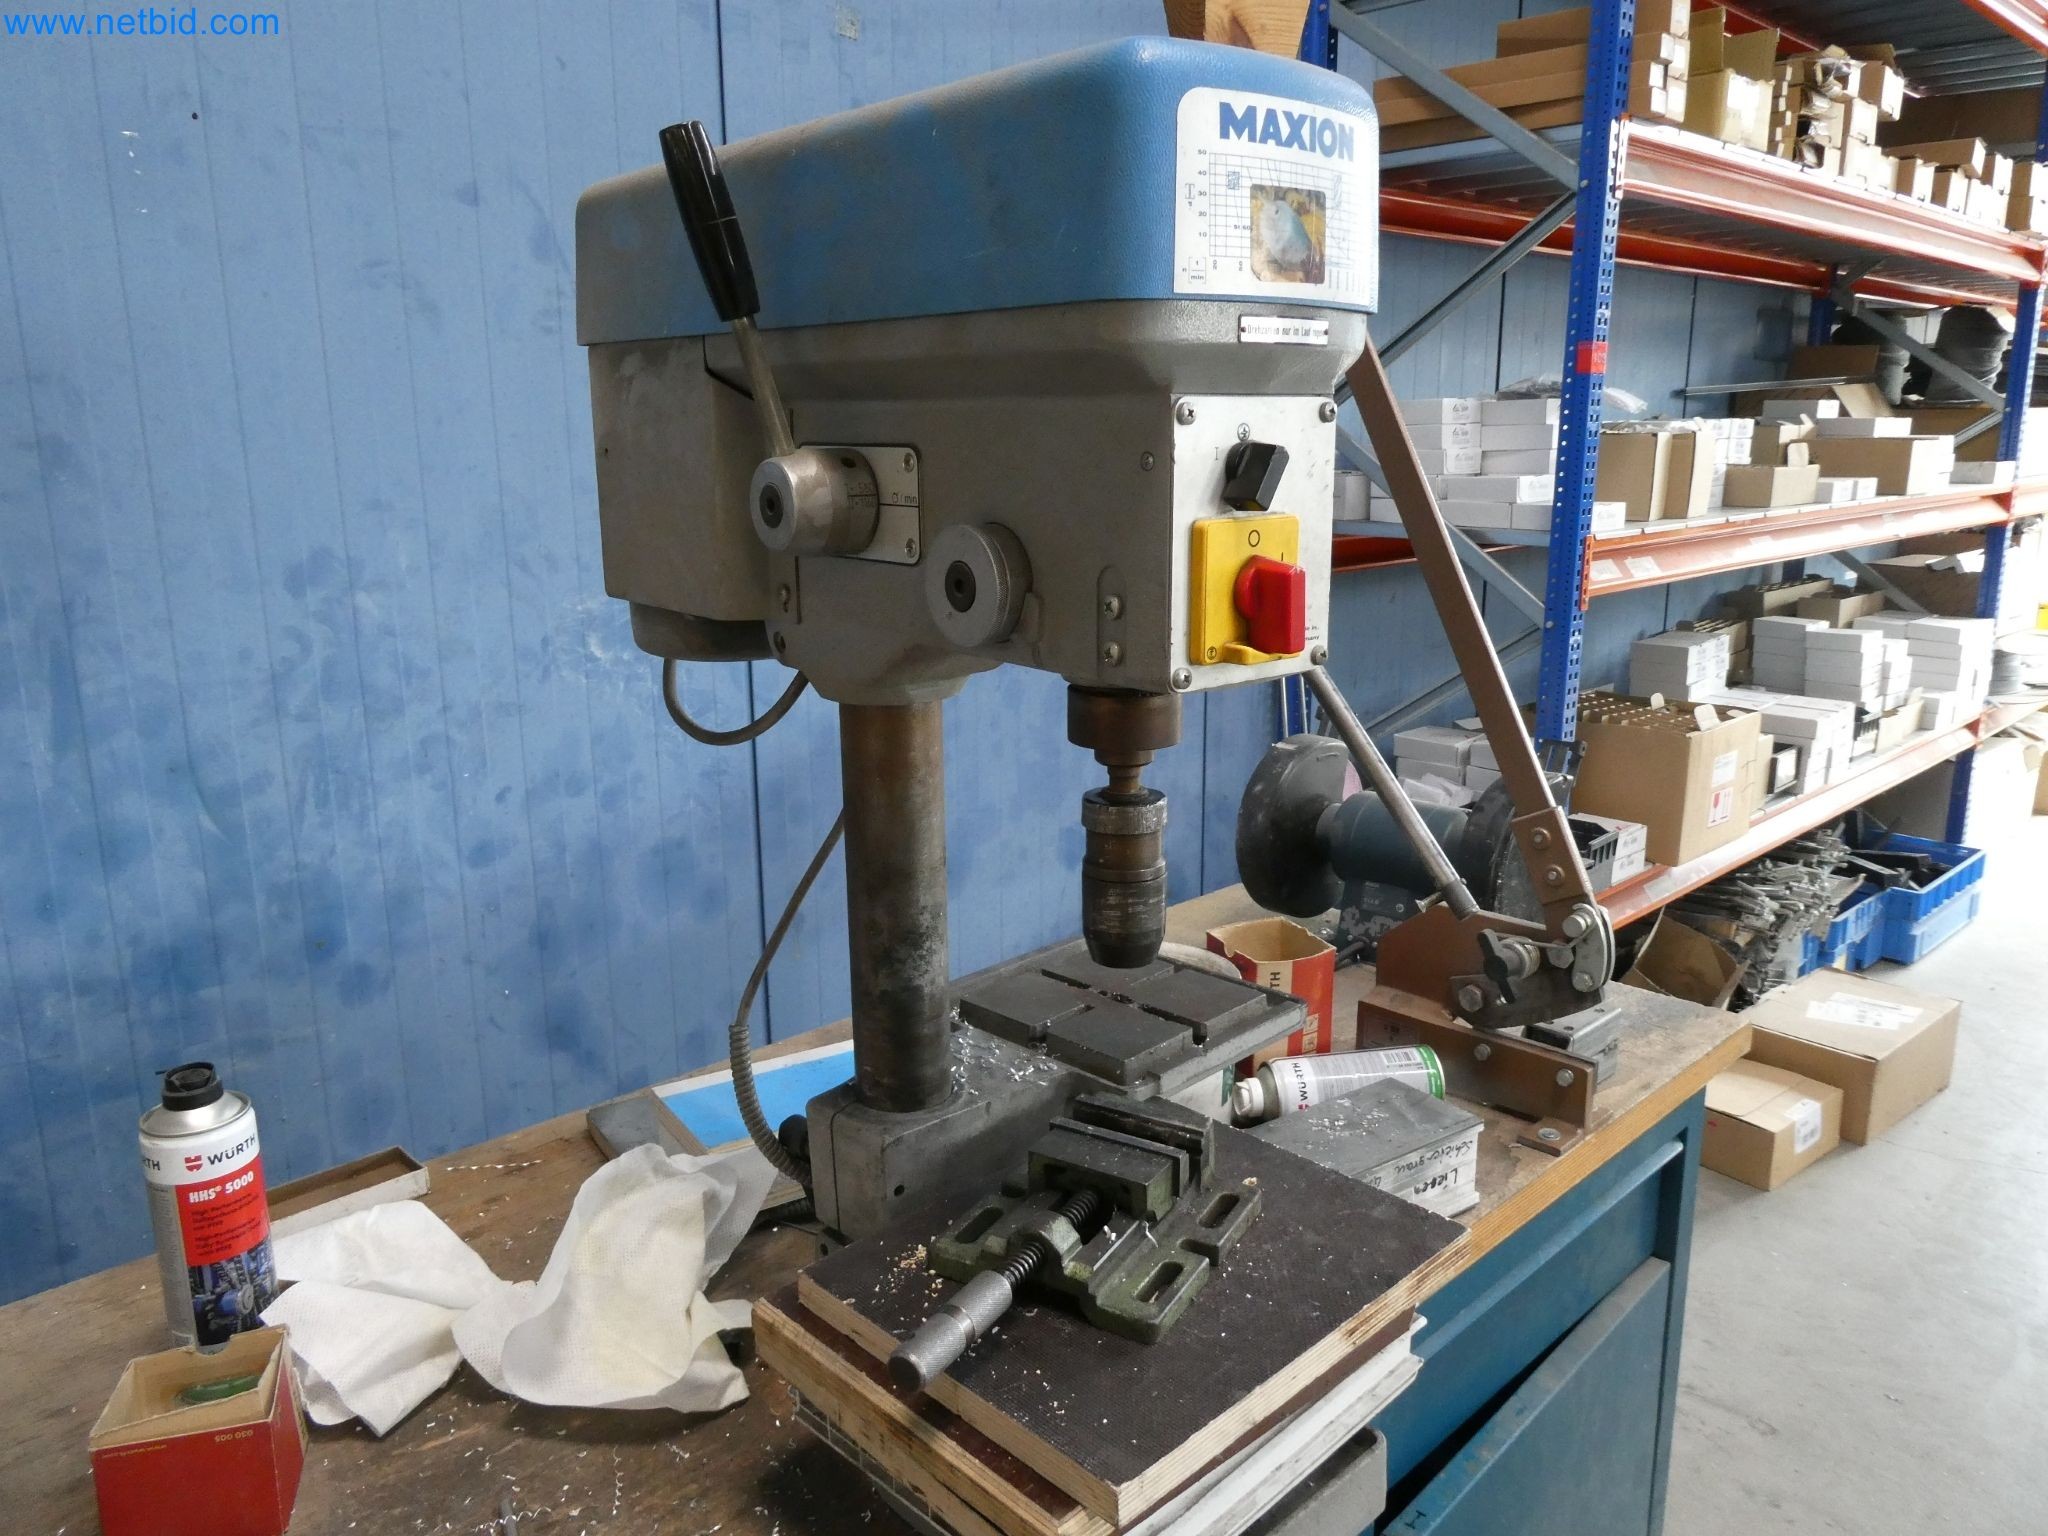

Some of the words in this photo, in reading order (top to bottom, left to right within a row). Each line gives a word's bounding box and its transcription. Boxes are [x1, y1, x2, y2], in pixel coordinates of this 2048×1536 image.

[1219, 101, 1354, 162] MAXION
[207, 1134, 257, 1166] WÜRTH
[225, 1170, 254, 1194] 5000
